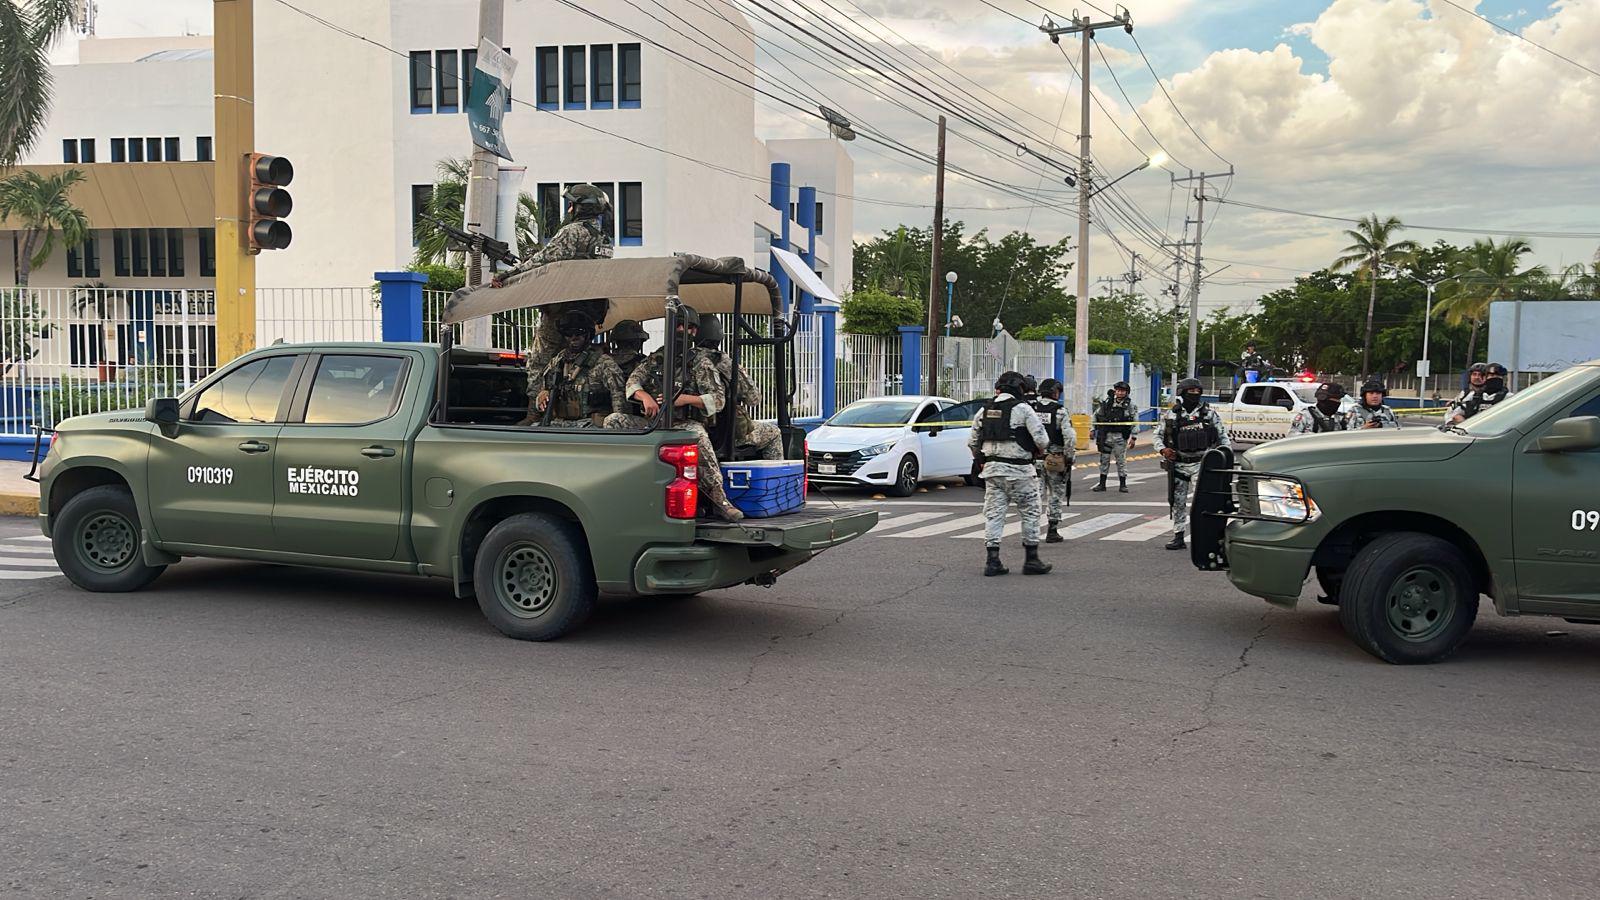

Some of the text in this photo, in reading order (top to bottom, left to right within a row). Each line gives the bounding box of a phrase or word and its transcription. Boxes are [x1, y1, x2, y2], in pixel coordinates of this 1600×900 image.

[155, 303, 215, 313] ACAEMI
[187, 466, 233, 485] 0910319
[287, 465, 359, 485] EJÉRCITO
[289, 482, 358, 497] MEXICANO
